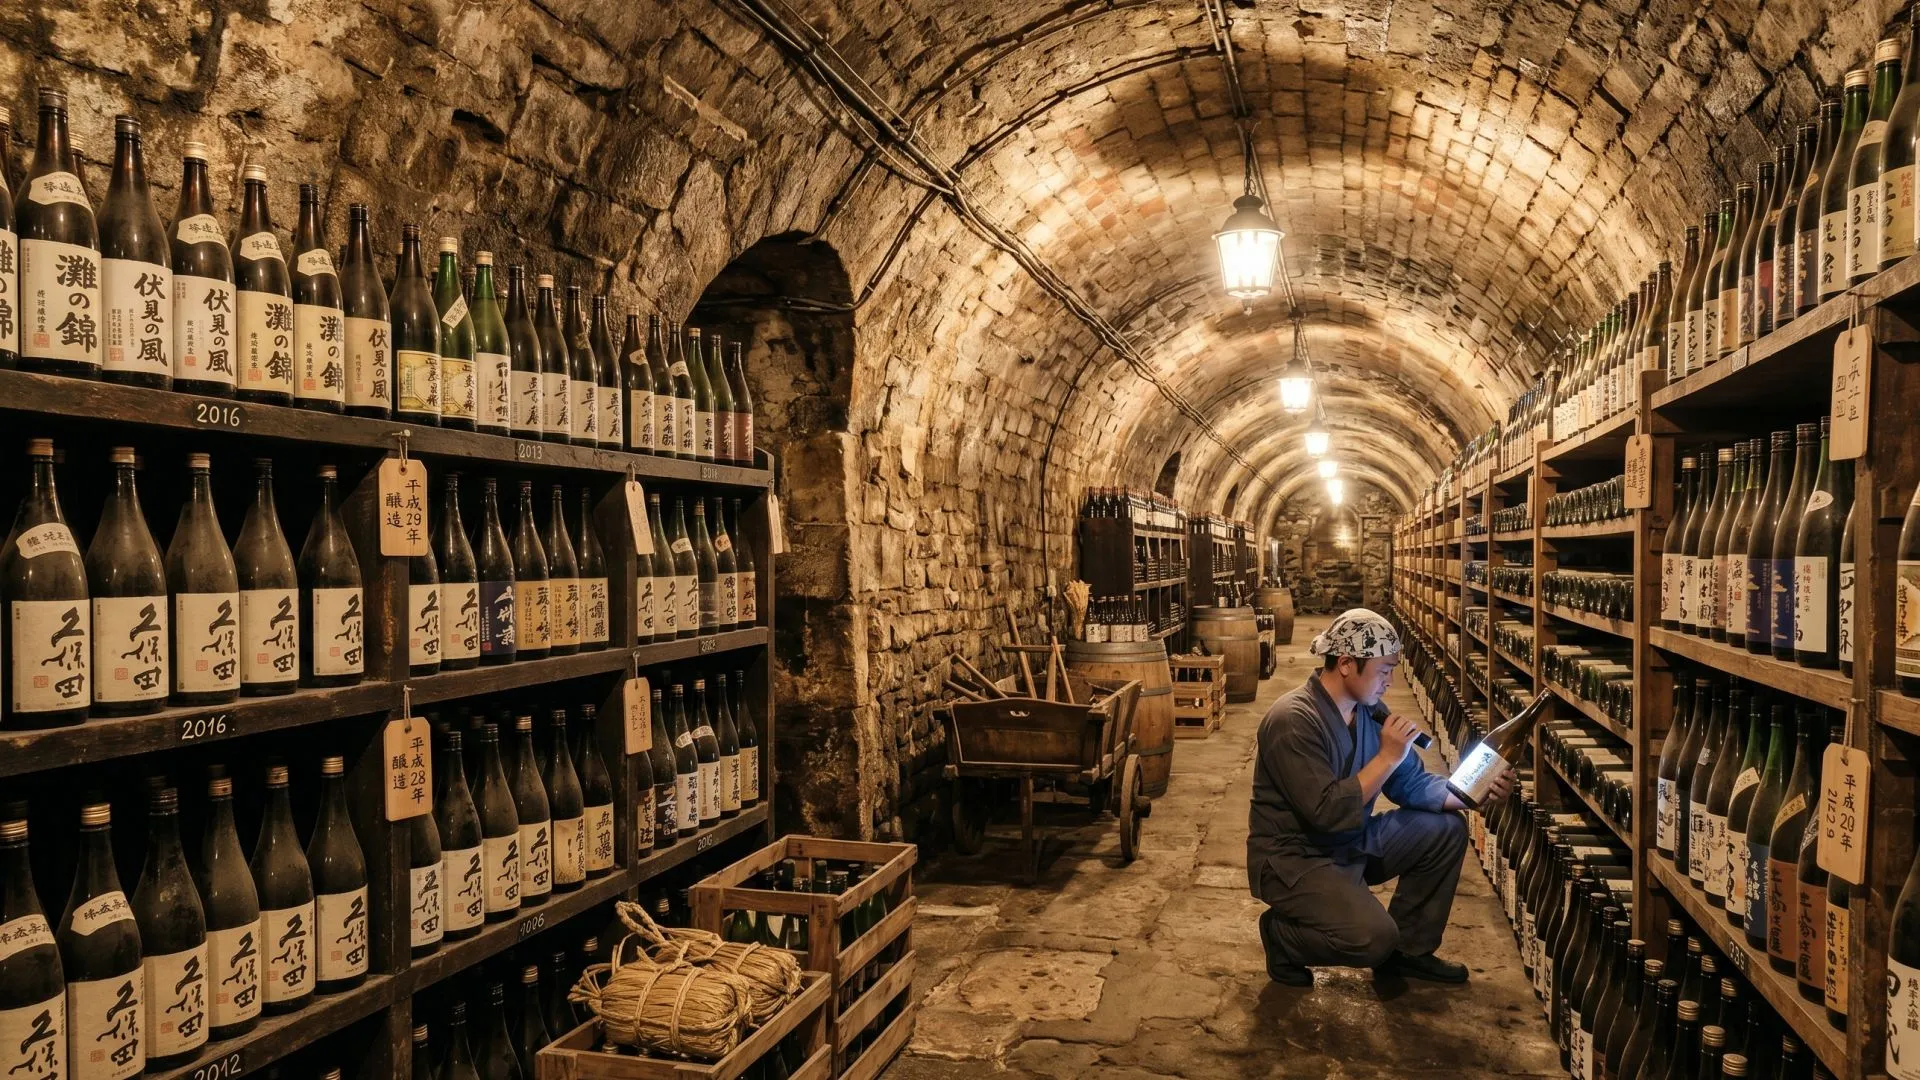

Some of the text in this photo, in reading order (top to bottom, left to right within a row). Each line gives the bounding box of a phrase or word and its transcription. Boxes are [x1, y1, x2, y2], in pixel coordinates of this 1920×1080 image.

[55, 254, 98, 354] 灘の錦
[134, 272, 168, 367] 伏見の風
[203, 288, 233, 377] 伏見の風
[265, 303, 293, 385] 灘の錦
[319, 315, 344, 394] 灘の錦
[368, 328, 390, 401] 伏見の風
[196, 403, 241, 427] 2016
[519, 443, 543, 460] 2013
[405, 479, 422, 546] 平成29年
[41, 606, 85, 698] 久保田
[121, 603, 162, 690] 久保田
[201, 599, 237, 680] 久保田
[263, 595, 296, 672] 久保田
[335, 593, 362, 665] 久保田
[415, 590, 440, 655] 久保田
[455, 588, 479, 650] 久保田
[410, 736, 426, 804] 平成28年
[458, 852, 483, 917] 久保田
[497, 840, 519, 900] 久保田
[526, 827, 549, 886] 久保田
[336, 895, 366, 965] 久保田
[412, 869, 440, 934] 久保田
[222, 931, 257, 1008] 久保田
[271, 914, 307, 987] 久保田
[96, 980, 140, 1066] 久保田
[165, 955, 204, 1038] 久保田
